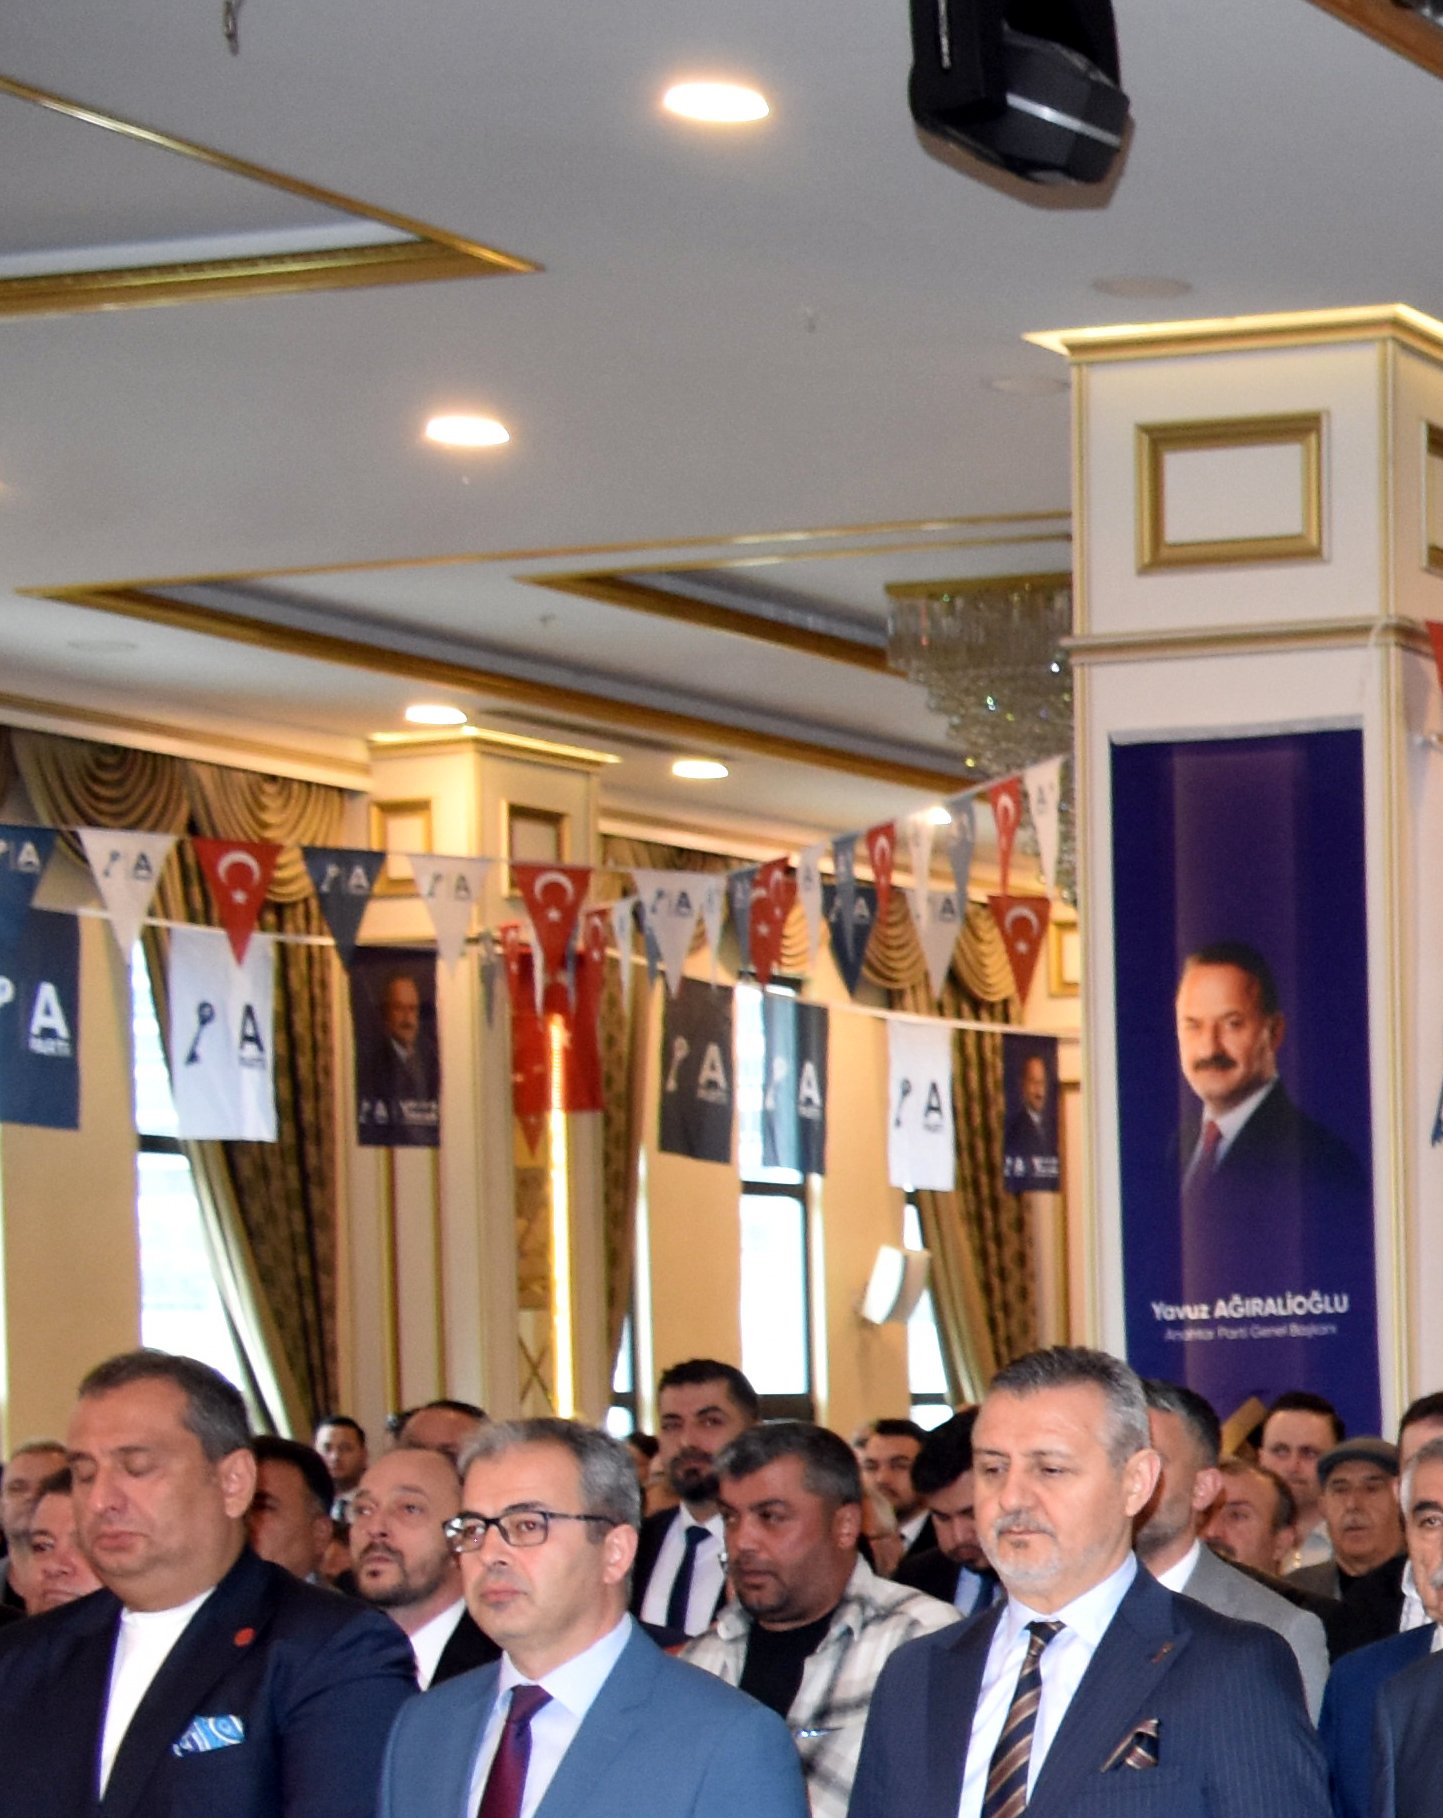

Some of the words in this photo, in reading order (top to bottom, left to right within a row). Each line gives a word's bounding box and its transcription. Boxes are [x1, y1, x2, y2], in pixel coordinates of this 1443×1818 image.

[18, 841, 40, 867] A
[134, 852, 152, 872] A
[352, 864, 369, 888] A
[456, 875, 470, 893] A
[676, 891, 692, 909] A
[854, 897, 869, 917] A
[940, 898, 954, 916] A
[31, 981, 71, 1040] A
[240, 1003, 264, 1053] A
[699, 1042, 728, 1090] A
[800, 1060, 821, 1109] A
[925, 1081, 943, 1119] A
[1150, 1302, 1209, 1321] Yavuz
[1213, 1289, 1350, 1319] AĞIRALİOĞLU
